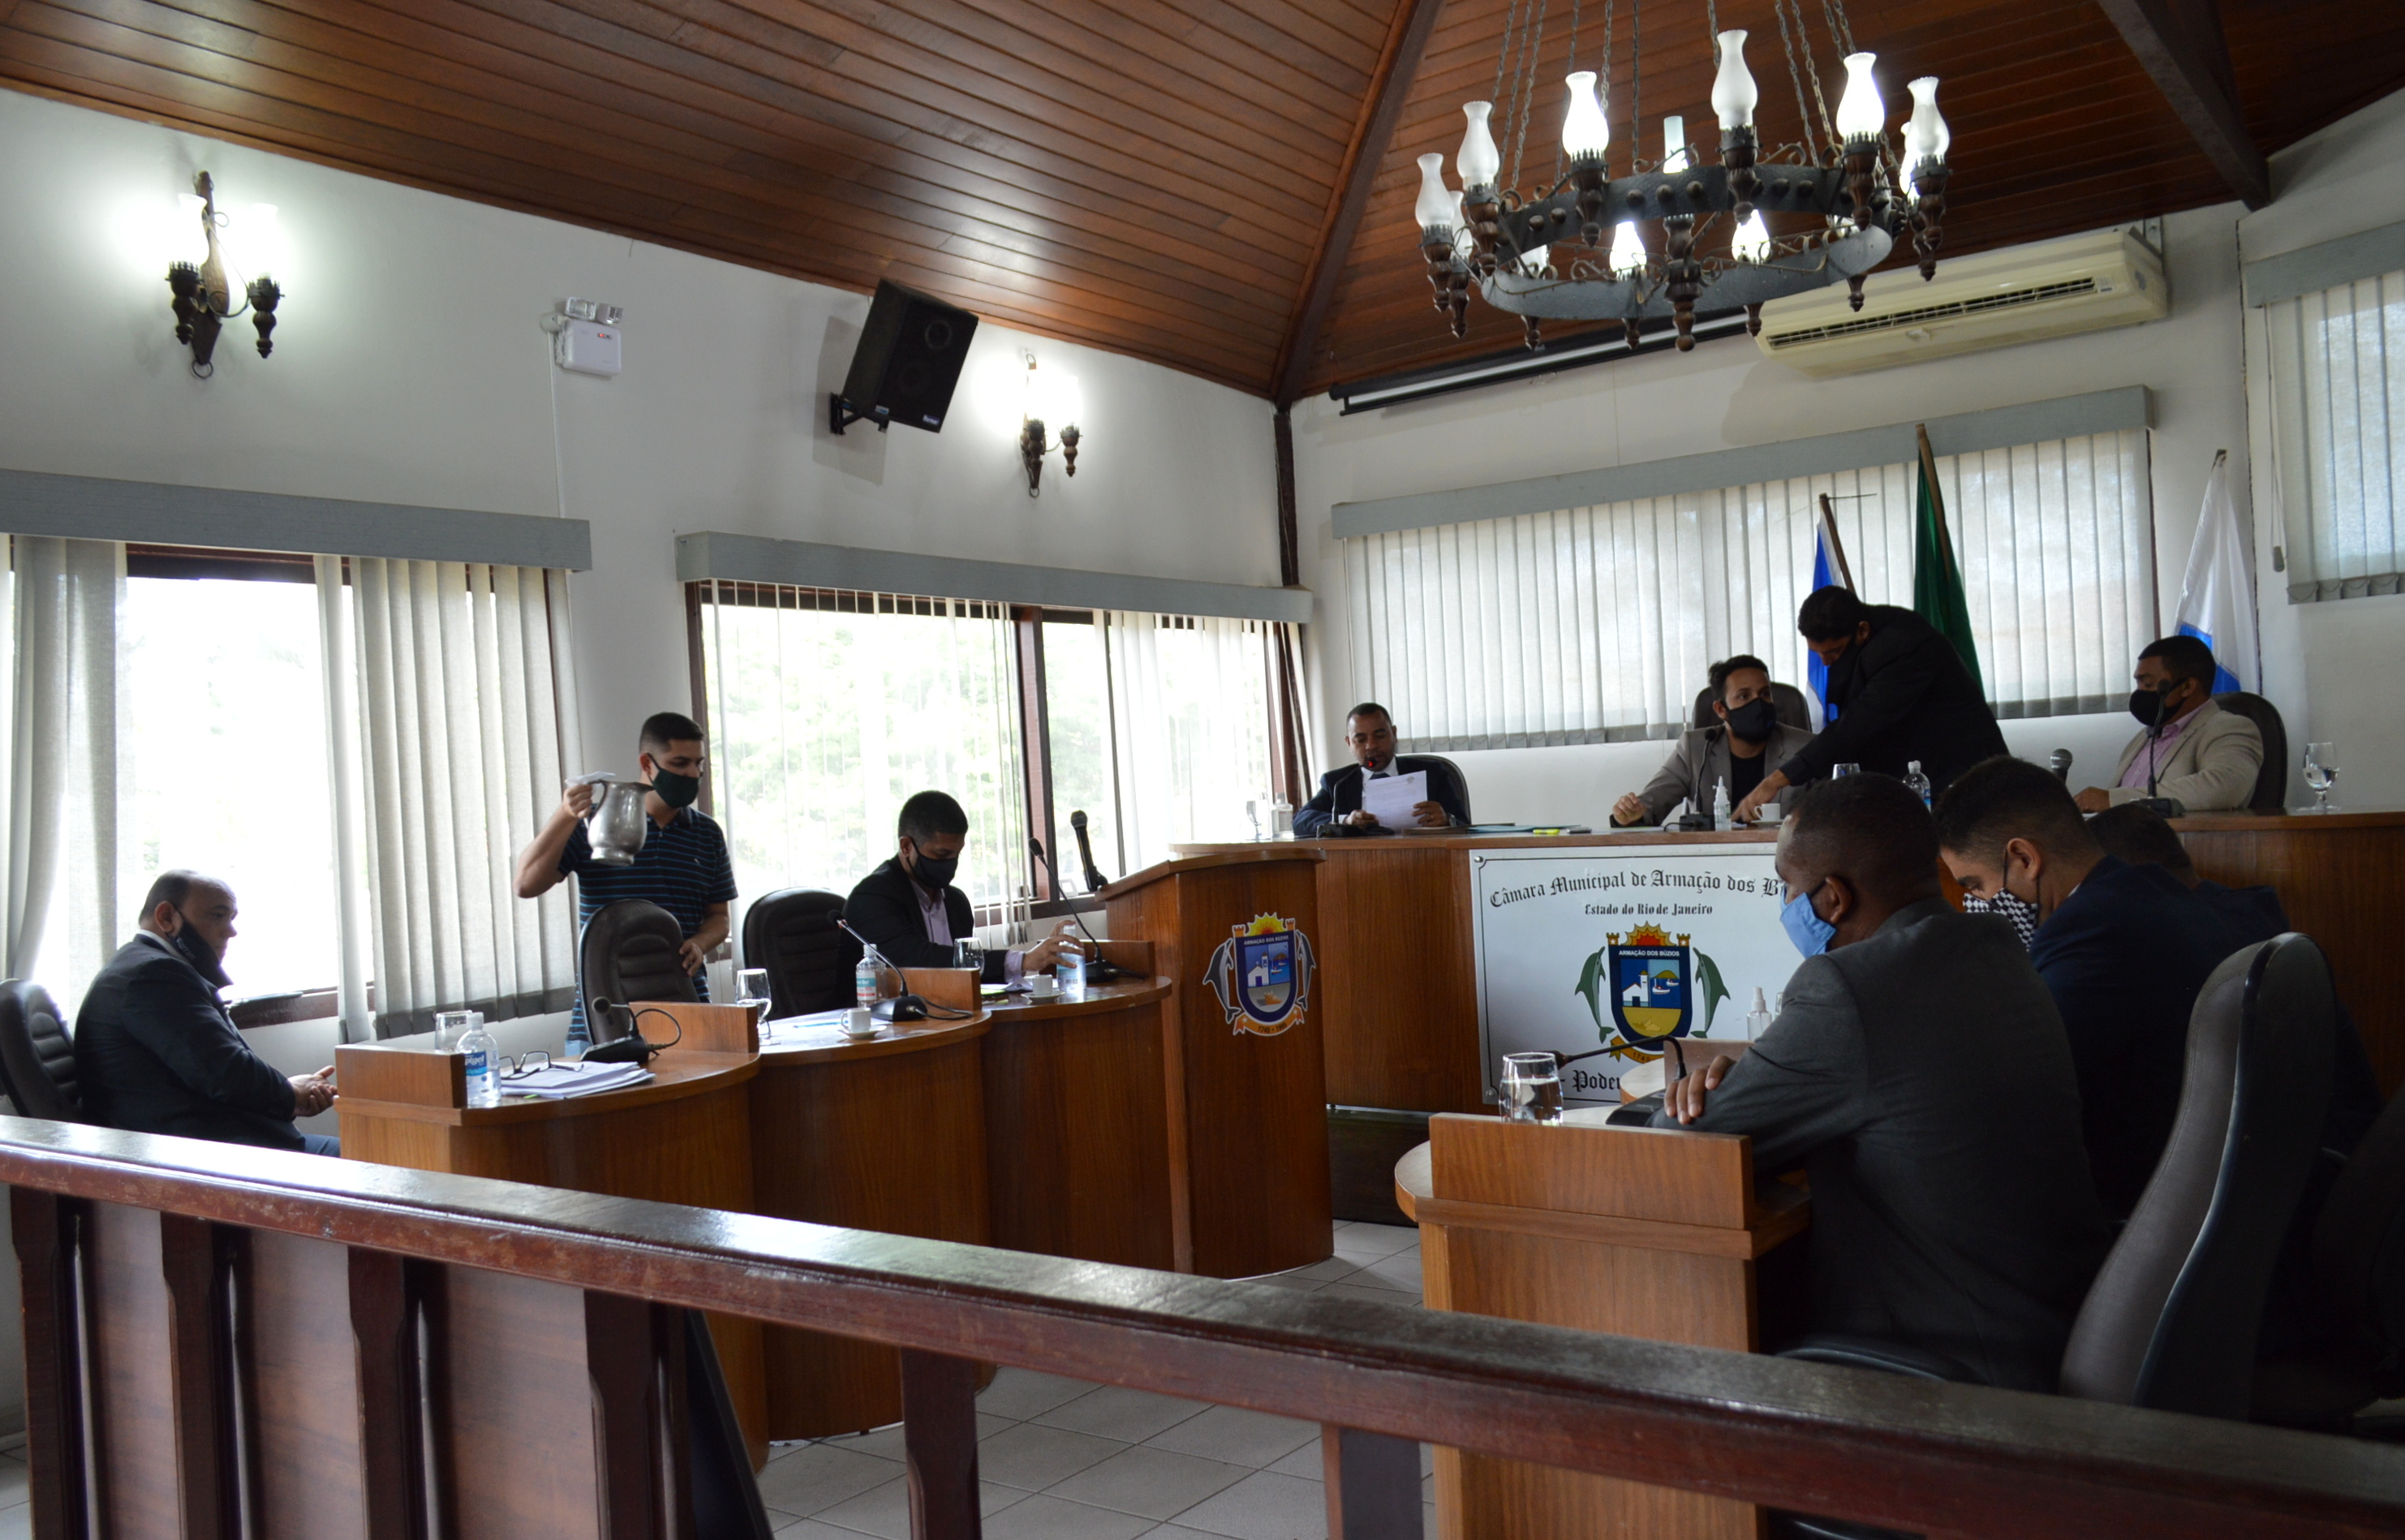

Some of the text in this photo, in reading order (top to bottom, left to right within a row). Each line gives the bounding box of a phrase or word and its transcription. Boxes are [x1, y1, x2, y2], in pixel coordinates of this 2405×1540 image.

[1490, 884, 1546, 908] Câmara
[1550, 871, 1626, 896] Municipal
[1631, 871, 1647, 888] de
[1650, 869, 1721, 894] Armação
[1727, 875, 1755, 893] dos
[1585, 903, 1714, 916] Estado do Rio de Janeiro
[1632, 1052, 1650, 1062] 1740
